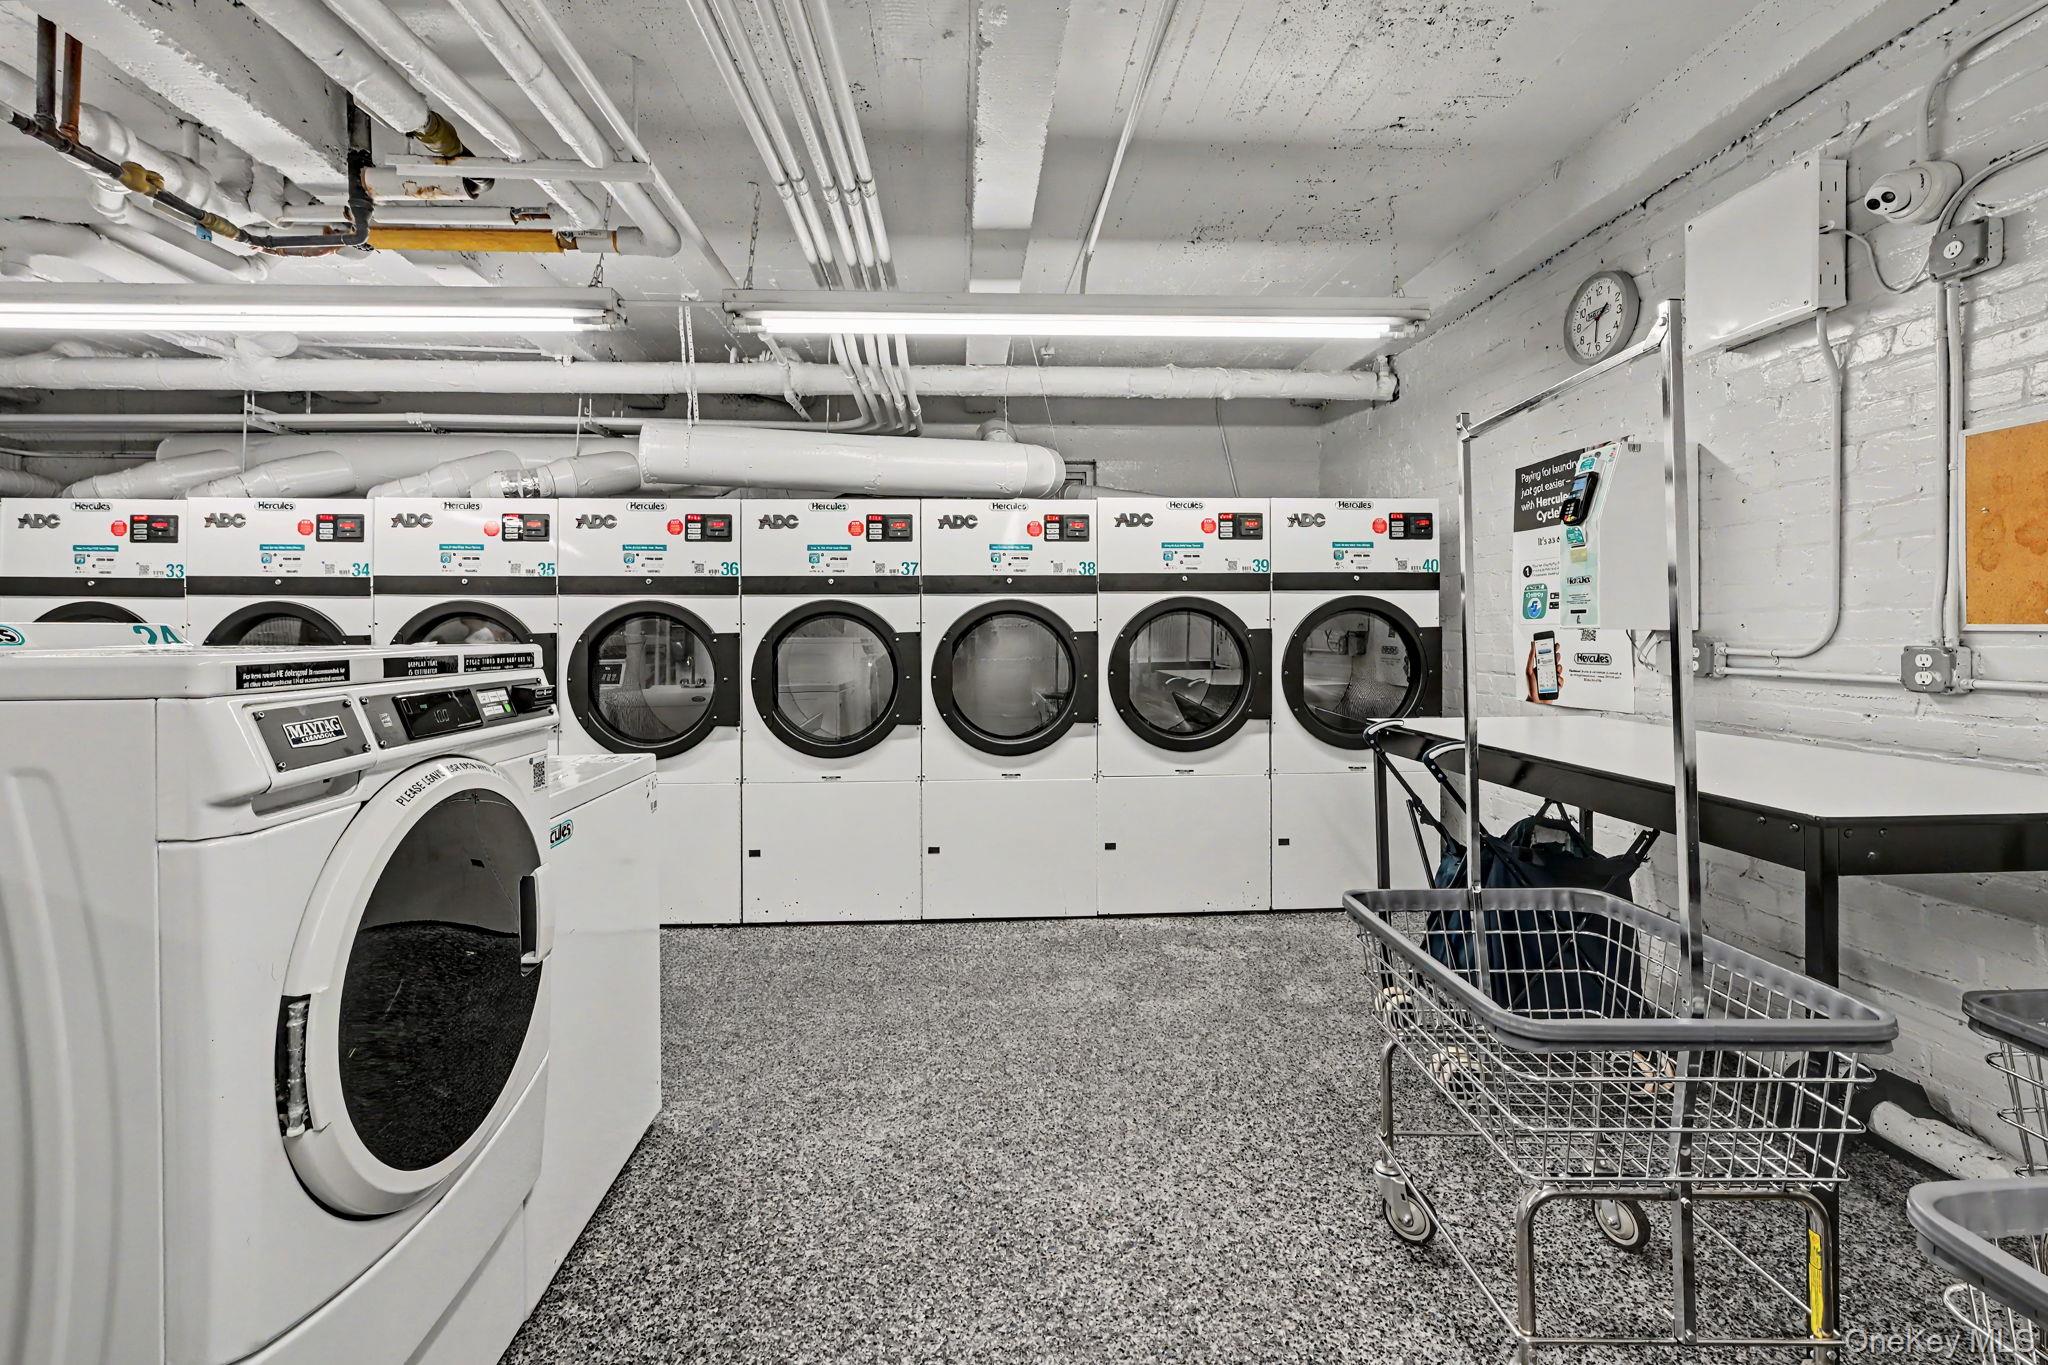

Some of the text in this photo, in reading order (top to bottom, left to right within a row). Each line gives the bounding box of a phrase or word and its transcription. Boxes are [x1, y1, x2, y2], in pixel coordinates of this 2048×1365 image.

[1596, 286, 1602, 296] 12
[1607, 286, 1610, 294] 1
[1586, 297, 1591, 306] 11
[1615, 292, 1620, 301] 2
[1580, 308, 1586, 319] 10
[1617, 304, 1622, 314] 3
[1577, 324, 1581, 333] 9
[1613, 321, 1619, 329] 4
[1580, 336, 1584, 345] 8
[1606, 333, 1611, 342] 5
[1587, 342, 1591, 352] 7
[1595, 342, 1600, 351] 6
[1521, 470, 1541, 484] Paying
[1541, 466, 1552, 477] for
[1520, 486, 1532, 500] just
[1532, 485, 1544, 497] got
[74, 502, 111, 511] Hercules
[258, 501, 294, 510] Hercules
[443, 501, 480, 511] Hercules
[630, 502, 665, 511] Hercules
[812, 502, 847, 511] Hercules
[992, 502, 1027, 511] Hercules
[1169, 501, 1203, 510] Hercules
[1338, 500, 1372, 509] Hercules
[1520, 492, 1570, 512] with Hercule
[1114, 512, 1154, 528] ADC
[1286, 512, 1326, 528] ADC
[1536, 506, 1562, 523] Cycle
[17, 513, 61, 529] ADC
[204, 512, 247, 529] ADC
[390, 513, 434, 529] ADC
[575, 514, 618, 530] ADC
[758, 514, 800, 530] ADC
[938, 514, 979, 530] ADC
[1538, 537, 1547, 546] It's
[166, 563, 185, 578] 33
[352, 562, 370, 577] 34
[538, 562, 556, 577] 35
[720, 562, 739, 576] 36
[901, 562, 919, 576] 37
[1078, 561, 1096, 576] 38
[1252, 558, 1270, 573] 39
[1422, 558, 1439, 573] 40
[1576, 653, 1610, 664] Hercules
[276, 670, 284, 678] HE
[287, 718, 341, 739] MAYTAG
[396, 780, 426, 806] PLEASE
[423, 767, 446, 786] LEAVE
